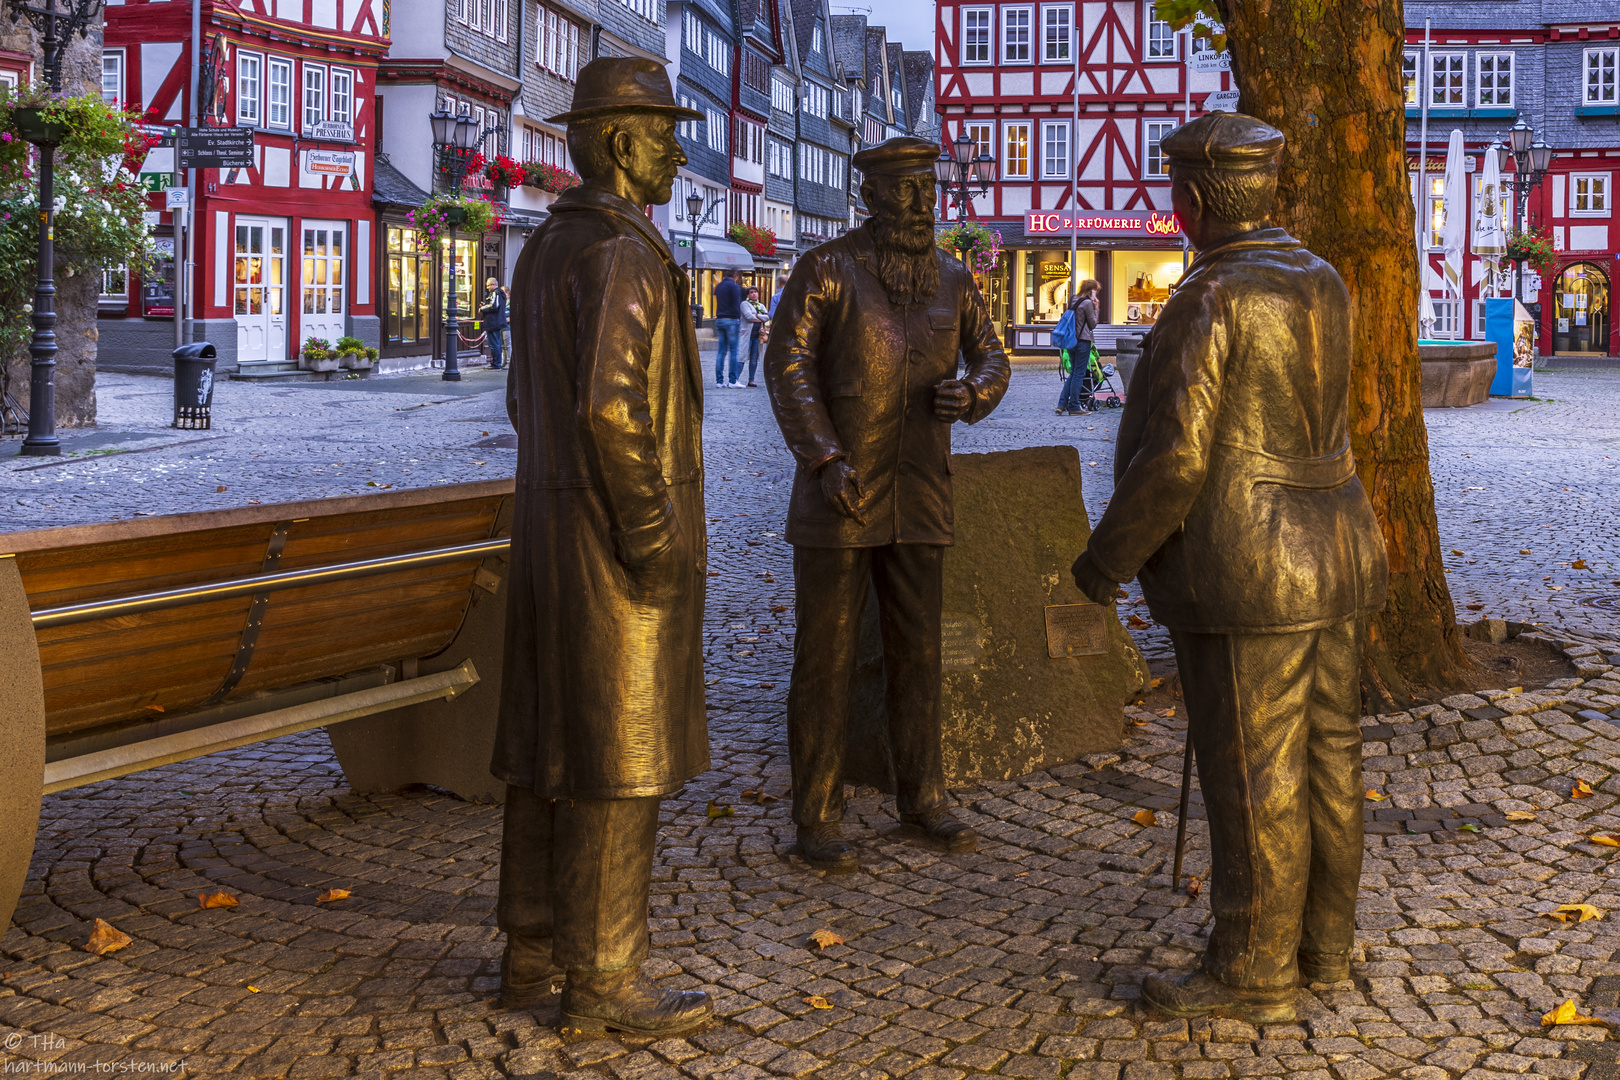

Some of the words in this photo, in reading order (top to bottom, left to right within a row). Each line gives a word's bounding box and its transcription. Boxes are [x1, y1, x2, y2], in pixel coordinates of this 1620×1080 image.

[316, 128, 351, 138] PRESSEHAUS
[208, 182, 216, 192] 41
[1029, 214, 1060, 232] HC
